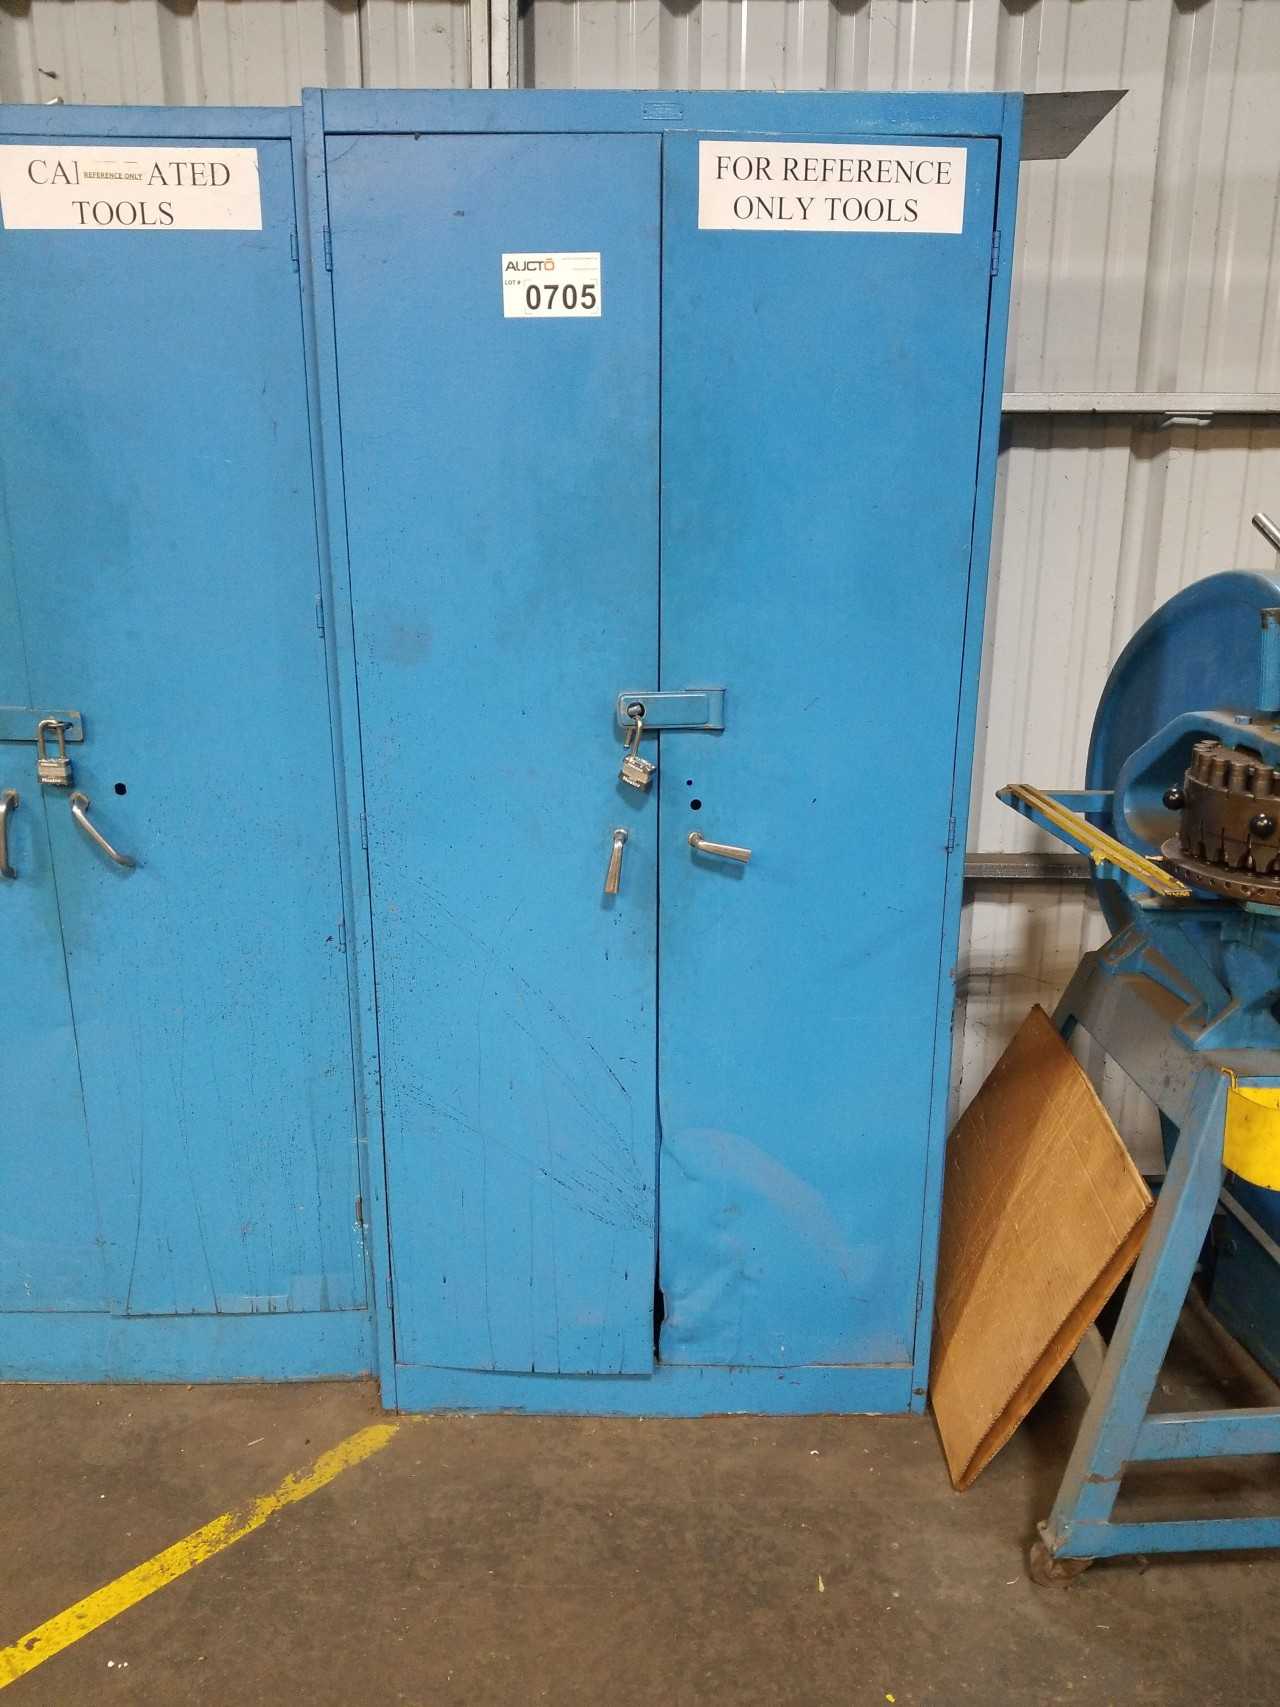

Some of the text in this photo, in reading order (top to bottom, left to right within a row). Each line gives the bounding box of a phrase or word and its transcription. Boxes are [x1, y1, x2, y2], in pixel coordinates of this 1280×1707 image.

[28, 160, 230, 186] CAATED
[83, 171, 122, 180] REFERENCE
[715, 155, 952, 184] FOR REFERENCE
[72, 201, 174, 225] TOOLS
[733, 195, 918, 223] ONLY TOOLS
[526, 285, 596, 309] 0705
